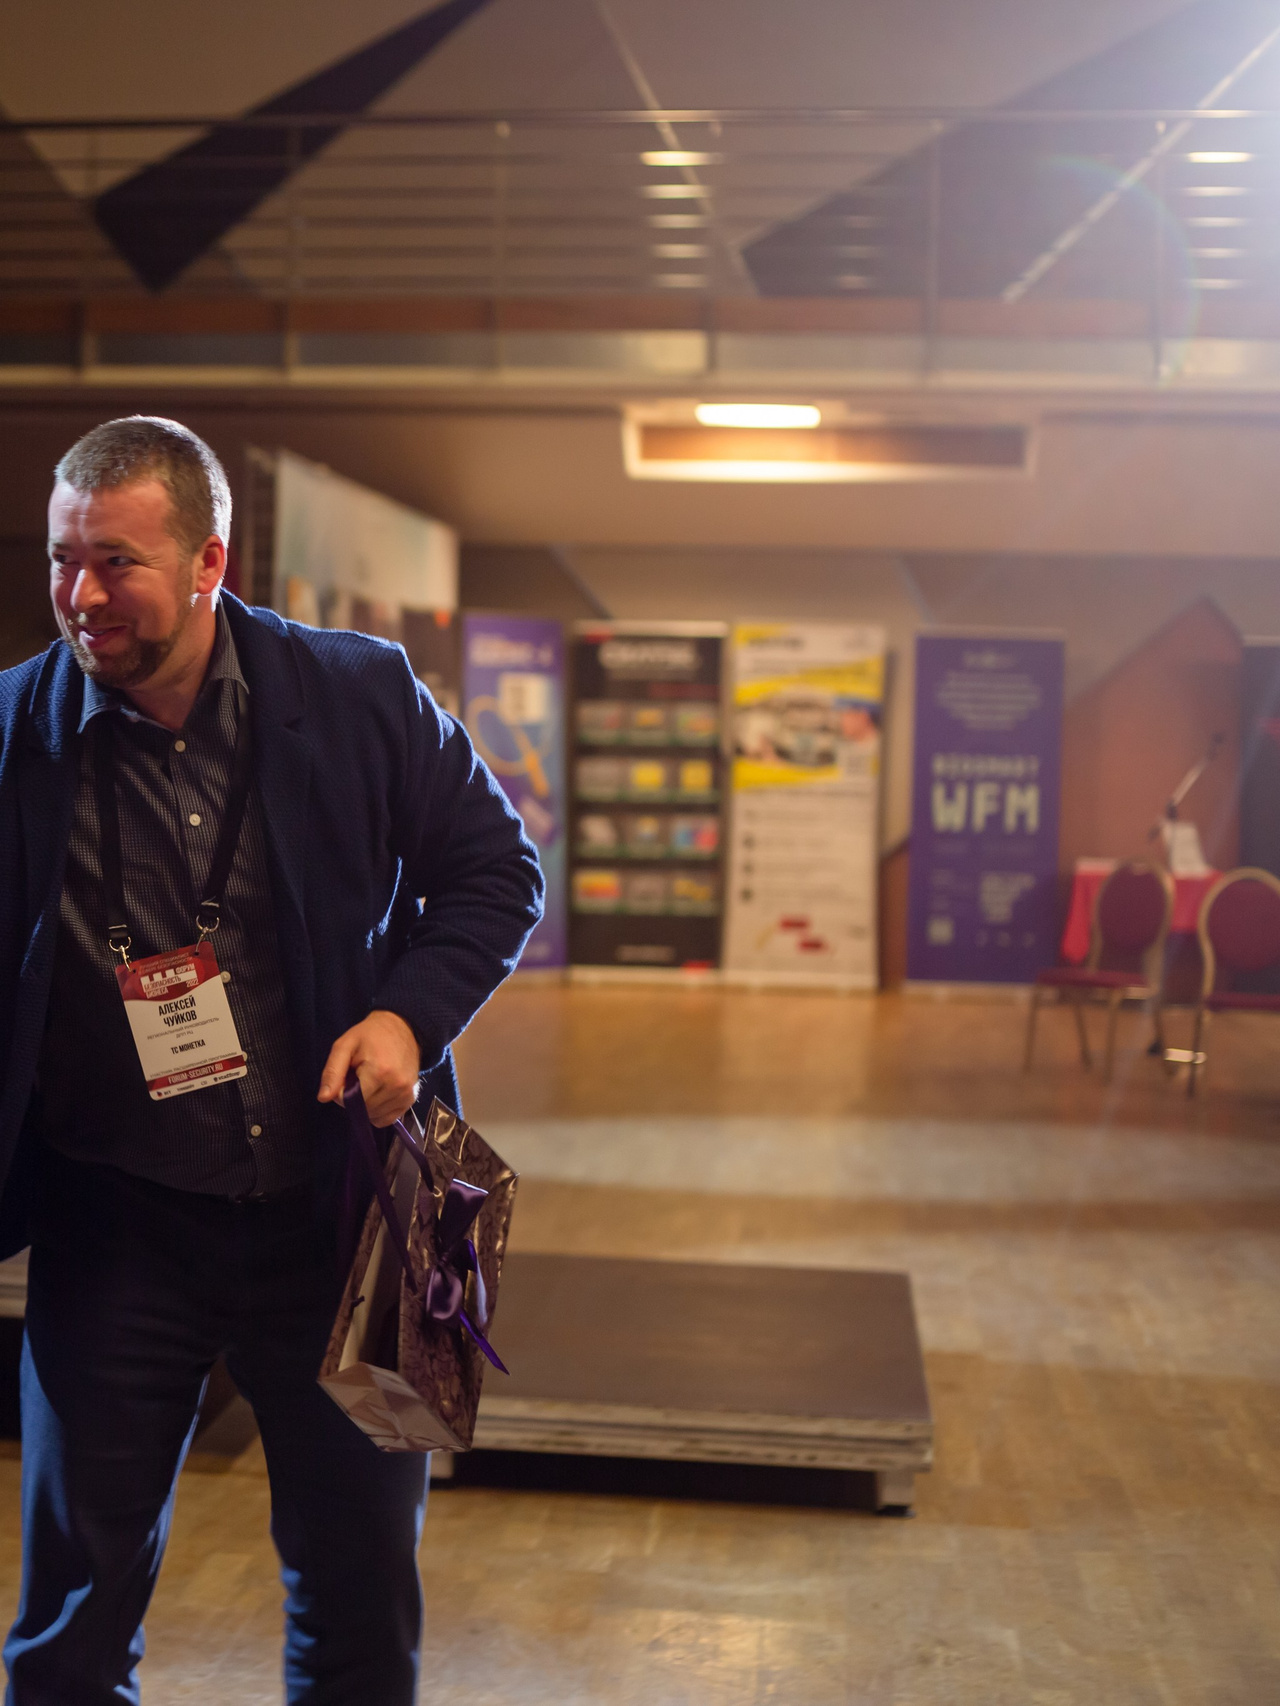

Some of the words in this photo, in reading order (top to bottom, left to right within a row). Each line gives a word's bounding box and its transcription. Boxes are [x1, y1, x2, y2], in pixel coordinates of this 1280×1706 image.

[933, 782, 1039, 835] WFM
[176, 963, 195, 973] ФОРУМ
[144, 975, 181, 990] БЕЗОПАСНОСТЬ
[158, 995, 196, 1016] АЛЕКСЕЙ
[163, 1010, 197, 1027] ЧУЙКОВ
[171, 1046, 178, 1054] ТС
[179, 1039, 205, 1052] МОНЕТКА
[168, 1063, 223, 1084] FORUM-SECURITY.RU
